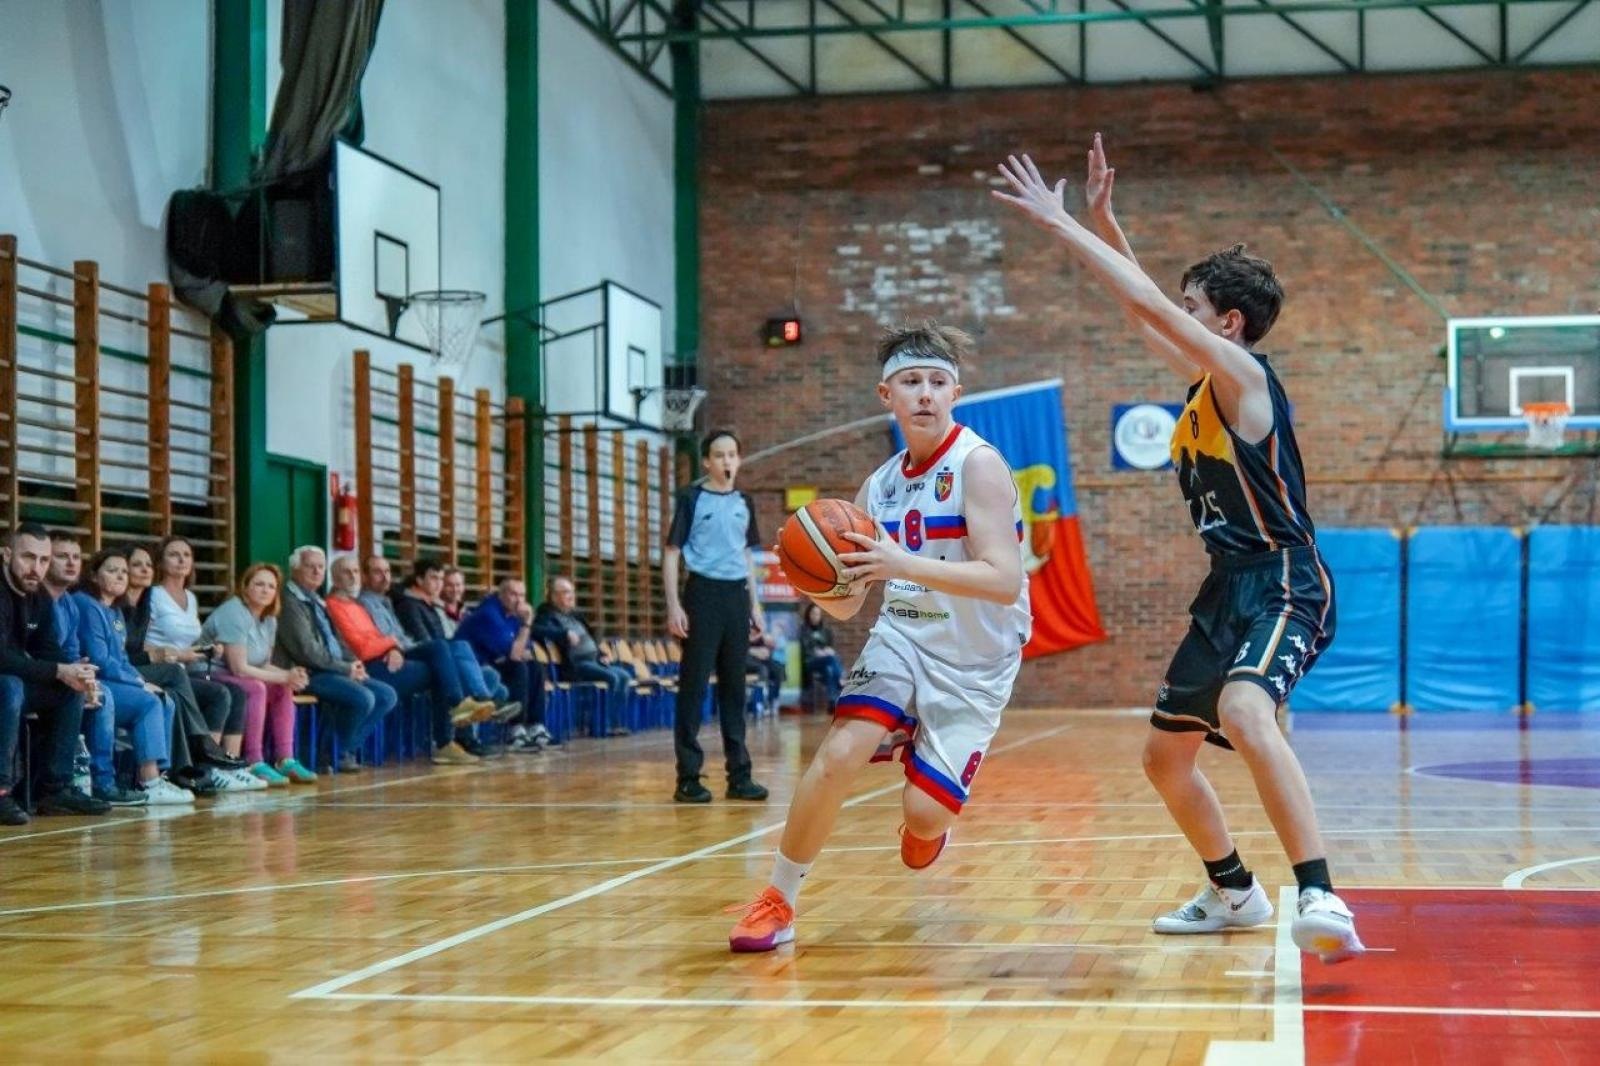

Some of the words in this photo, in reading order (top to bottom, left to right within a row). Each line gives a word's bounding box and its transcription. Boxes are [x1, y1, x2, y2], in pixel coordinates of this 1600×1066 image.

[1189, 410, 1199, 440] 8
[904, 509, 923, 552] 8
[960, 750, 982, 788] 8
